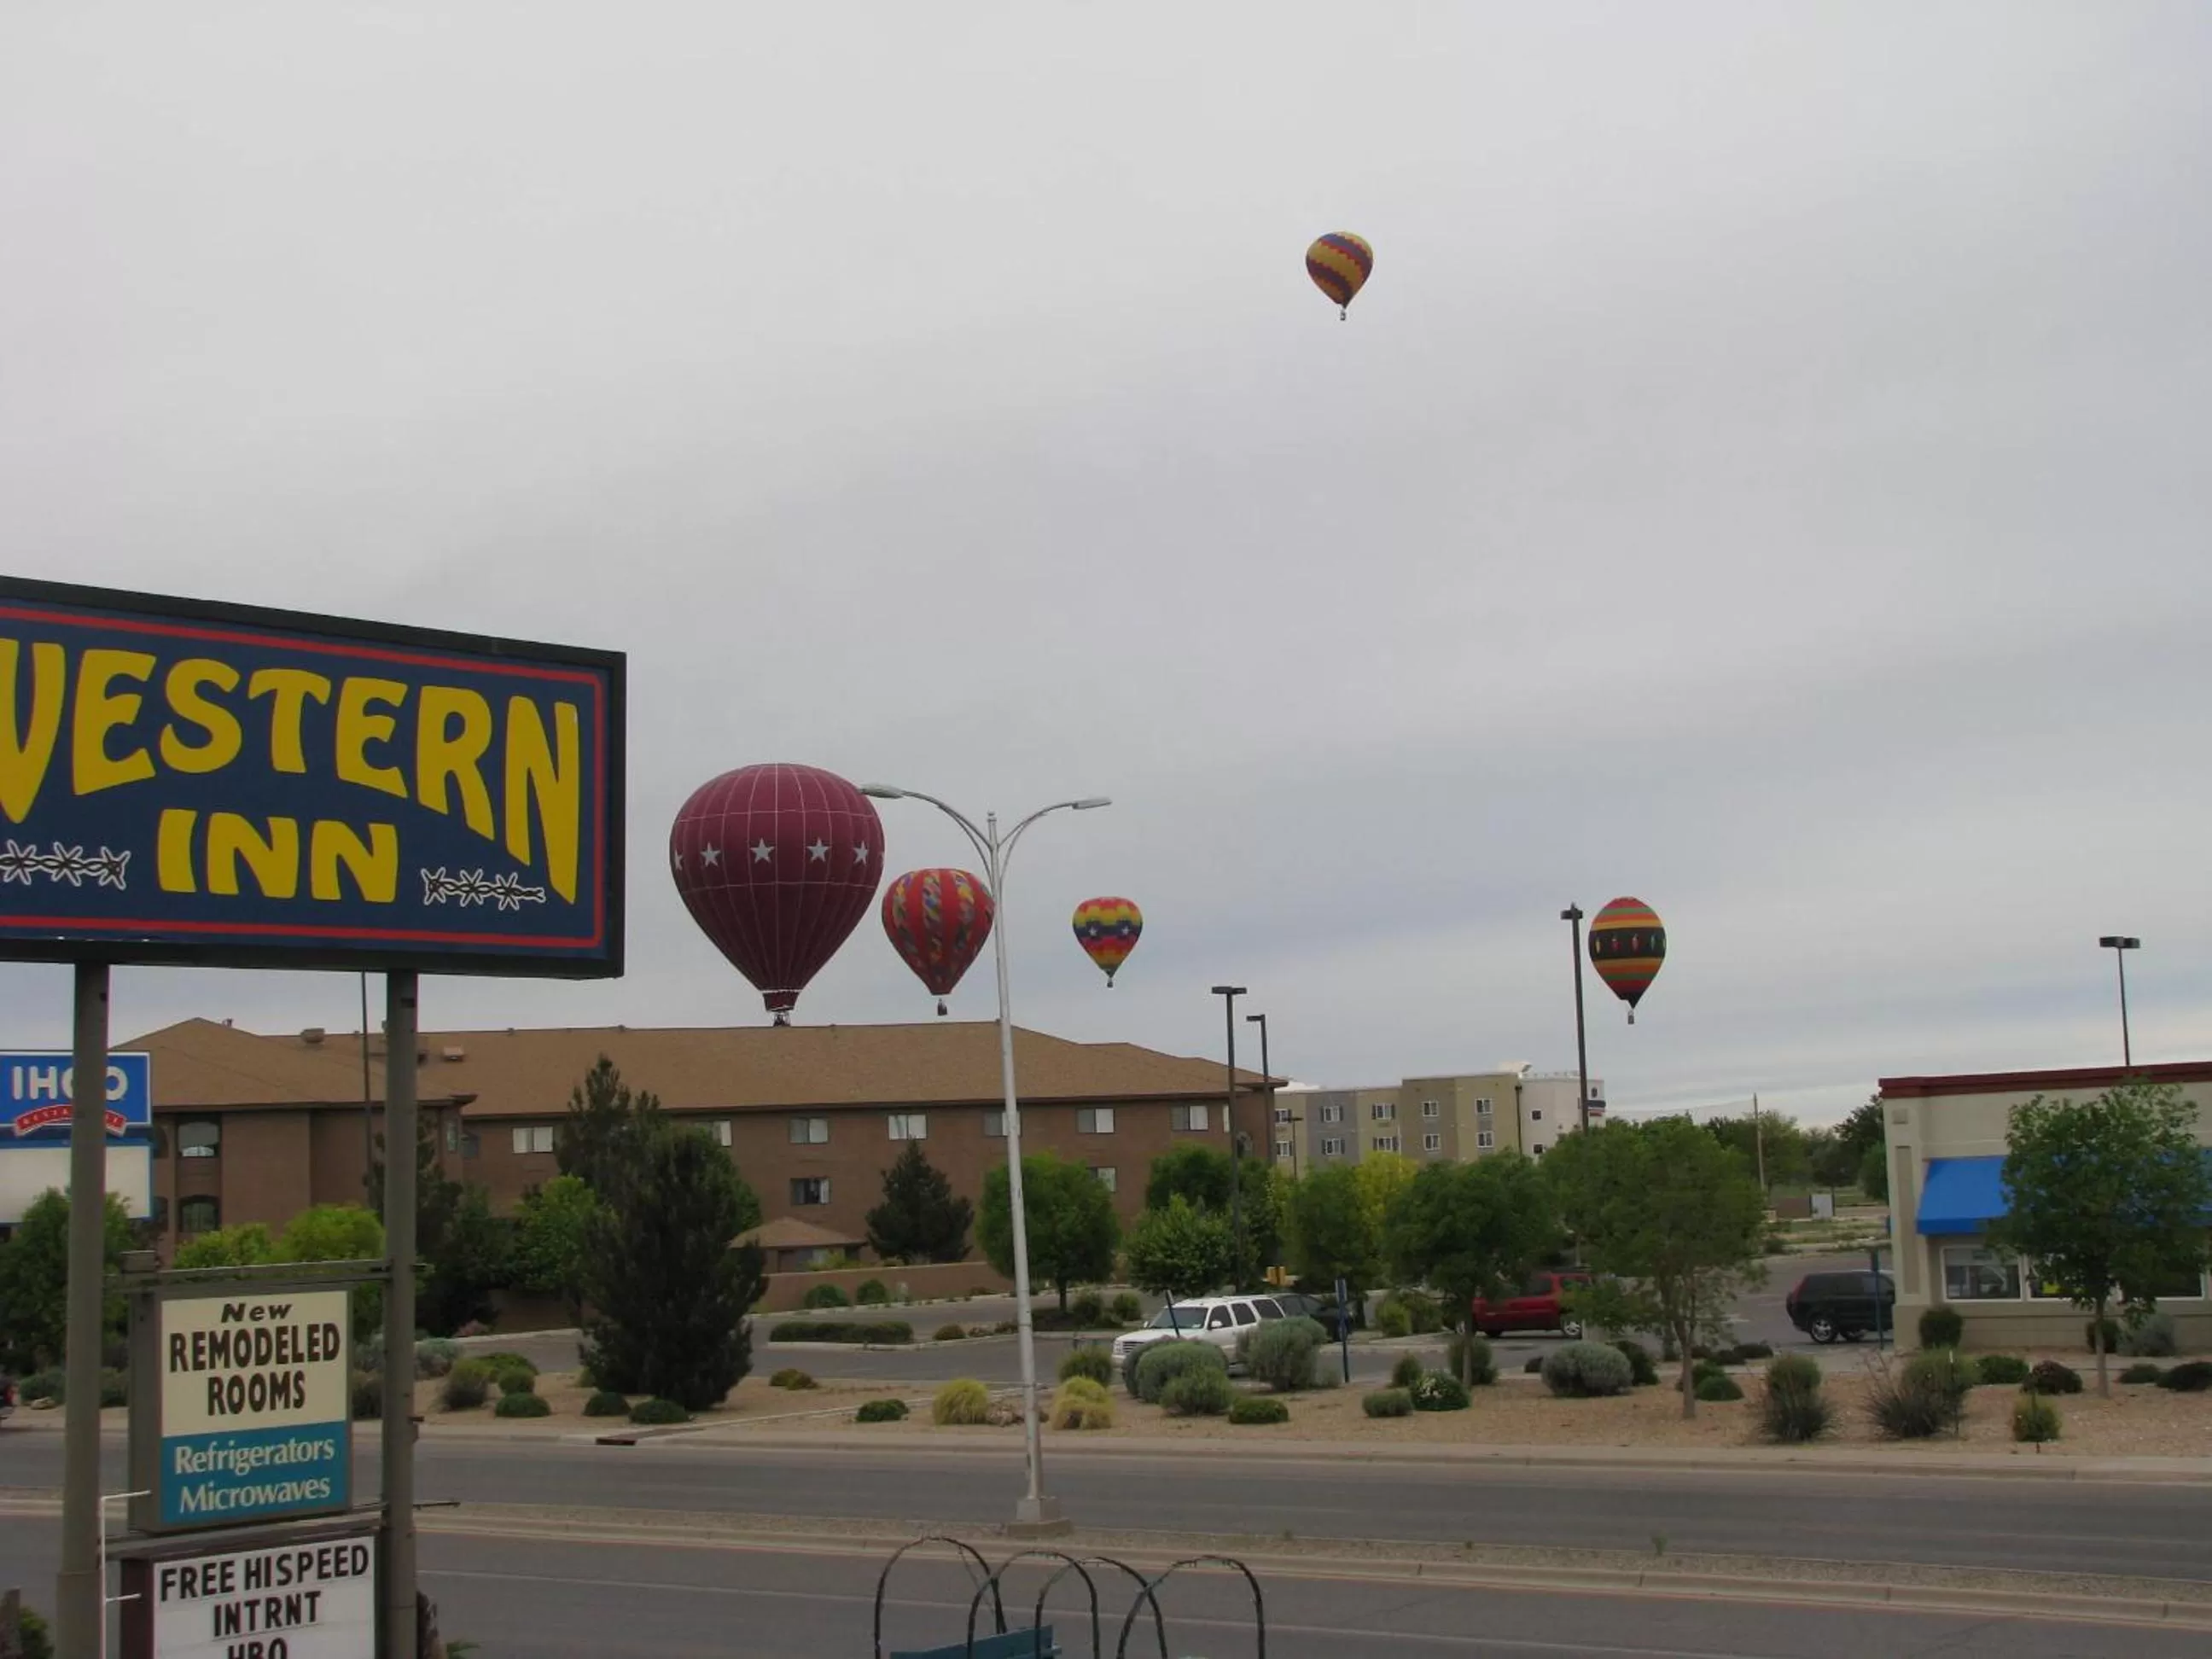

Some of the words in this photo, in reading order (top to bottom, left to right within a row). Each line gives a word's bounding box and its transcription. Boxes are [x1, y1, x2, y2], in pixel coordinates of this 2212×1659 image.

[157, 808, 399, 903] INN
[220, 1302, 292, 1324] New
[170, 1323, 341, 1373] REMODELED
[207, 1371, 306, 1416] ROOMS
[174, 1437, 335, 1476] Refrigerators
[179, 1477, 331, 1514] Microwaves
[160, 1560, 236, 1602] FREE
[244, 1545, 370, 1590] HISPEED
[213, 1591, 322, 1637] INTRNT
